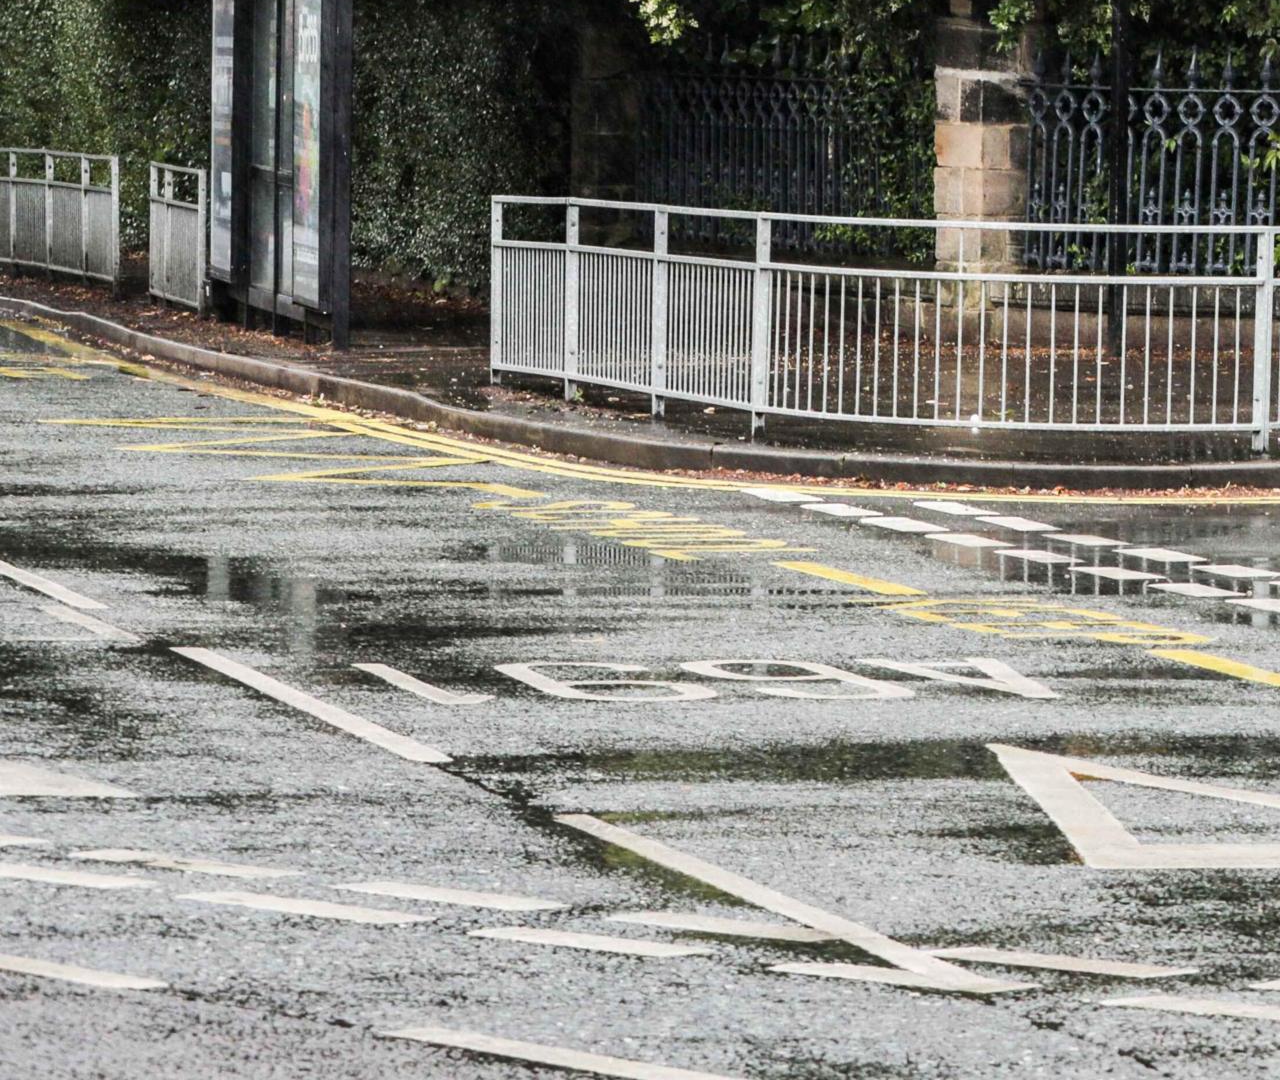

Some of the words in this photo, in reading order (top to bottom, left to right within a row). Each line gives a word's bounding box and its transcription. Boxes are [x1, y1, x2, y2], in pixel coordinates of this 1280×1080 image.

[472, 500, 819, 561] SCHOOL
[848, 598, 1214, 645] KEEP
[349, 657, 1064, 705] A691
